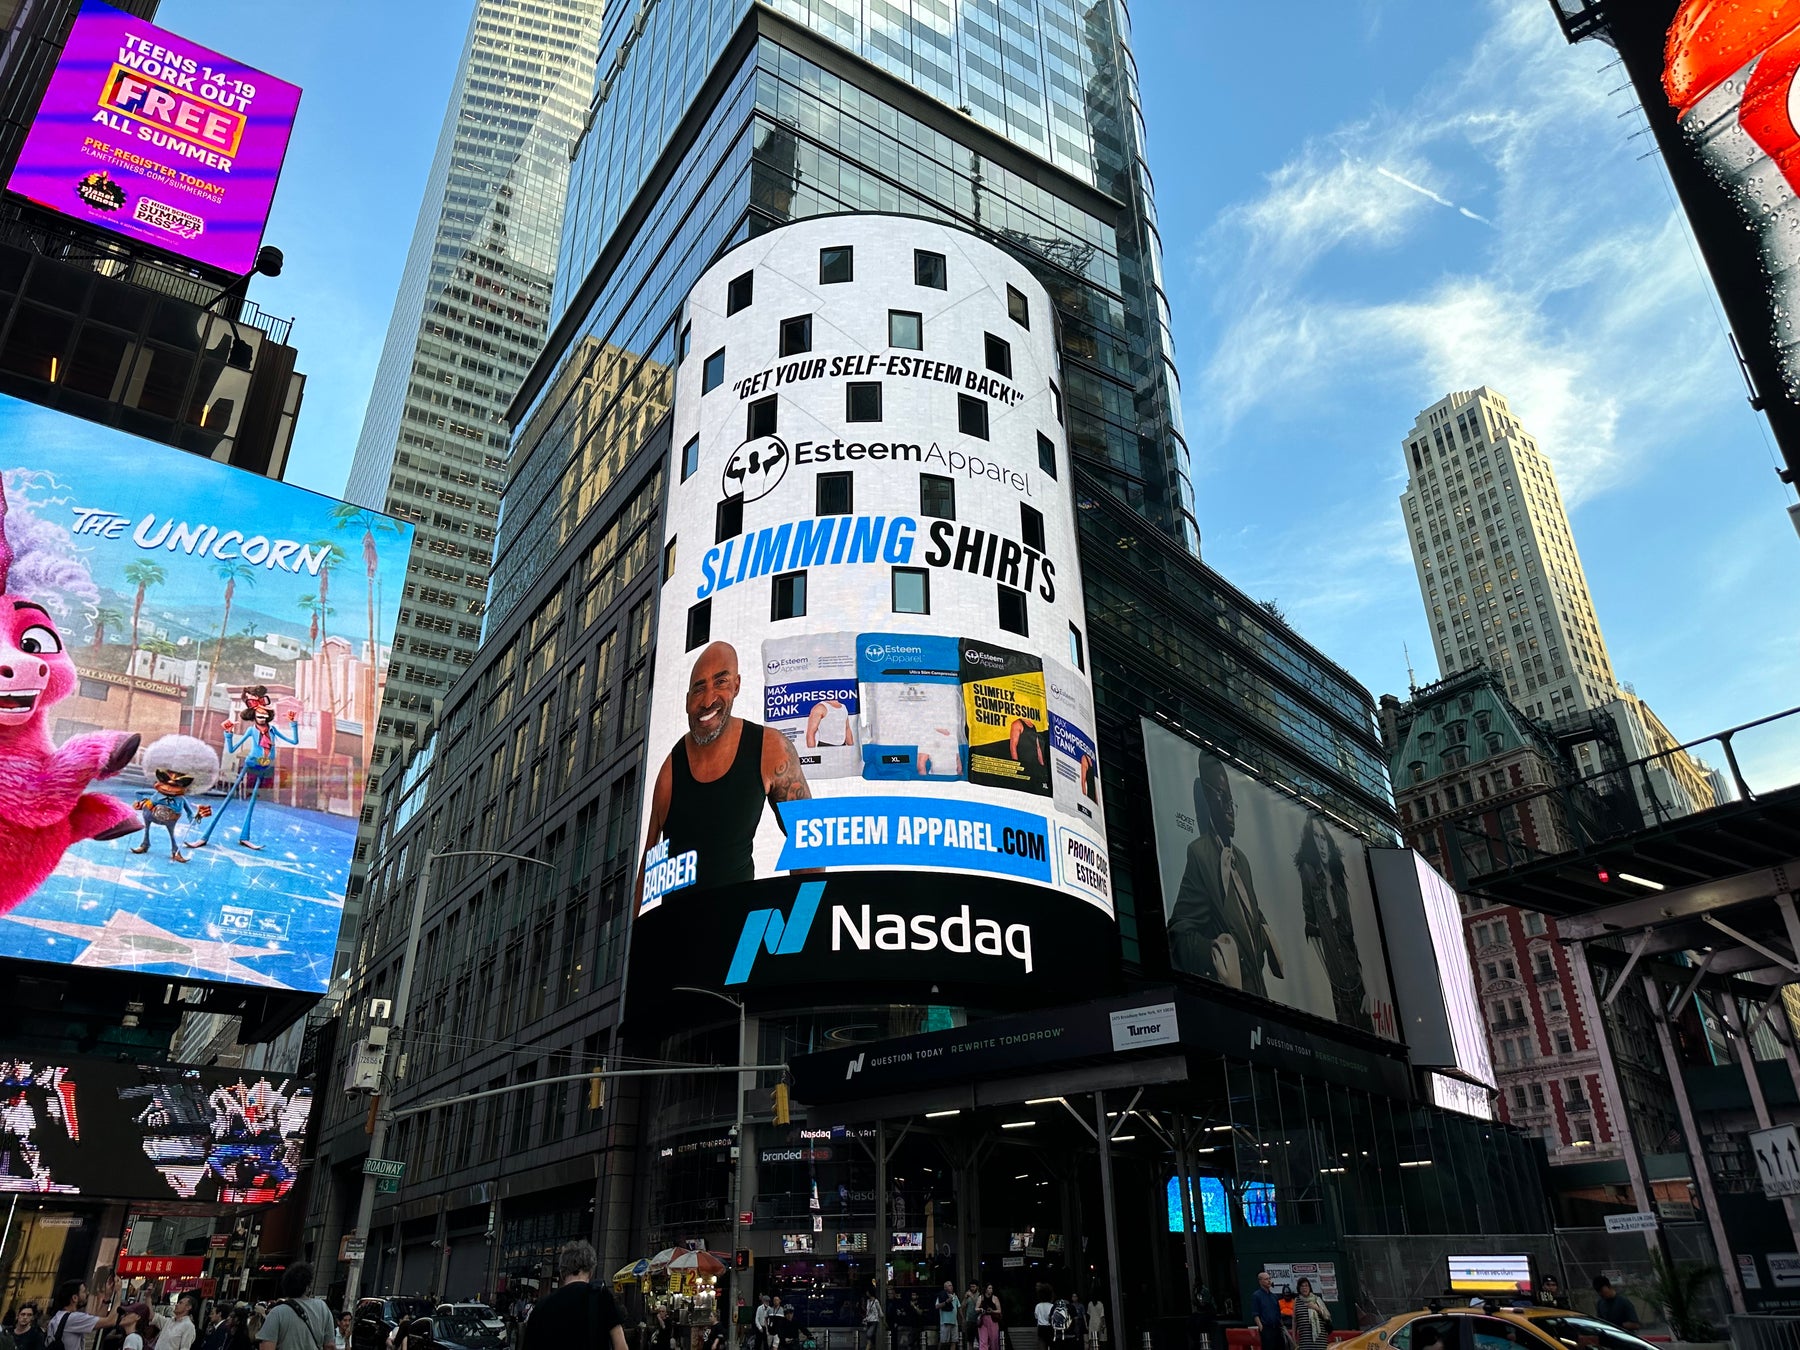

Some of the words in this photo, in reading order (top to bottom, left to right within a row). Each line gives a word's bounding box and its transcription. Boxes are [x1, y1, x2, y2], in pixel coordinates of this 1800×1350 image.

[124, 32, 198, 74] TEENS
[202, 66, 256, 98] 14-19
[118, 48, 196, 92] WORK
[200, 83, 251, 112] OUT
[115, 76, 233, 144] FREE
[92, 110, 132, 135] ALL
[137, 126, 232, 173] SUMMER
[81, 146, 222, 204] PLANETFITNESS.COM/SUMMERPASS
[84, 137, 176, 178] PRE-REGISTER
[180, 172, 225, 197] TODAY!
[81, 186, 114, 201] planet
[84, 193, 119, 209] fitness
[137, 211, 171, 230] PASS
[140, 203, 201, 232] SUMMER
[150, 202, 170, 212] HIGH
[172, 206, 202, 224] SCHOOL
[775, 358, 827, 387] YOUR
[829, 355, 962, 386] SELF-ESTEEM
[71, 507, 131, 541] THE
[132, 512, 332, 577] UNICORN
[697, 516, 917, 600] SLIMMING
[925, 520, 1056, 603] SHIRTS
[885, 645, 922, 654] Esteem
[886, 654, 922, 663] Apparel
[979, 652, 1004, 664] Esteem
[781, 657, 809, 666] Esteem
[980, 659, 1004, 670] Apparel
[100, 672, 131, 684] VINTAG
[136, 680, 178, 694] CLOTHING
[768, 686, 787, 696] MAX
[974, 684, 1015, 702] SLIMFLEX
[767, 690, 858, 706] COMPRESSION
[768, 704, 799, 718] TANK
[974, 696, 1040, 722] COMPRESSION
[976, 709, 1007, 726] SHIRT
[1053, 716, 1067, 728] MAX
[1055, 735, 1076, 756] TANK
[795, 815, 888, 850] ESTEEM
[646, 838, 670, 870] RONDE
[1068, 838, 1095, 866] PROMO
[642, 850, 698, 903] BARBER
[221, 914, 249, 928] PG
[831, 903, 1034, 974] Nasdaq
[1127, 1024, 1161, 1036] Turner
[871, 1053, 912, 1067] QUESTION
[916, 1048, 944, 1060] TODAY
[951, 1038, 996, 1054] REWRITE
[1000, 1028, 1063, 1046] TOMORROW
[1266, 1037, 1294, 1052] QUESTION
[1295, 1044, 1312, 1056] TODAY
[800, 1130, 831, 1139] Nasdaq
[378, 1180, 388, 1190] 43
